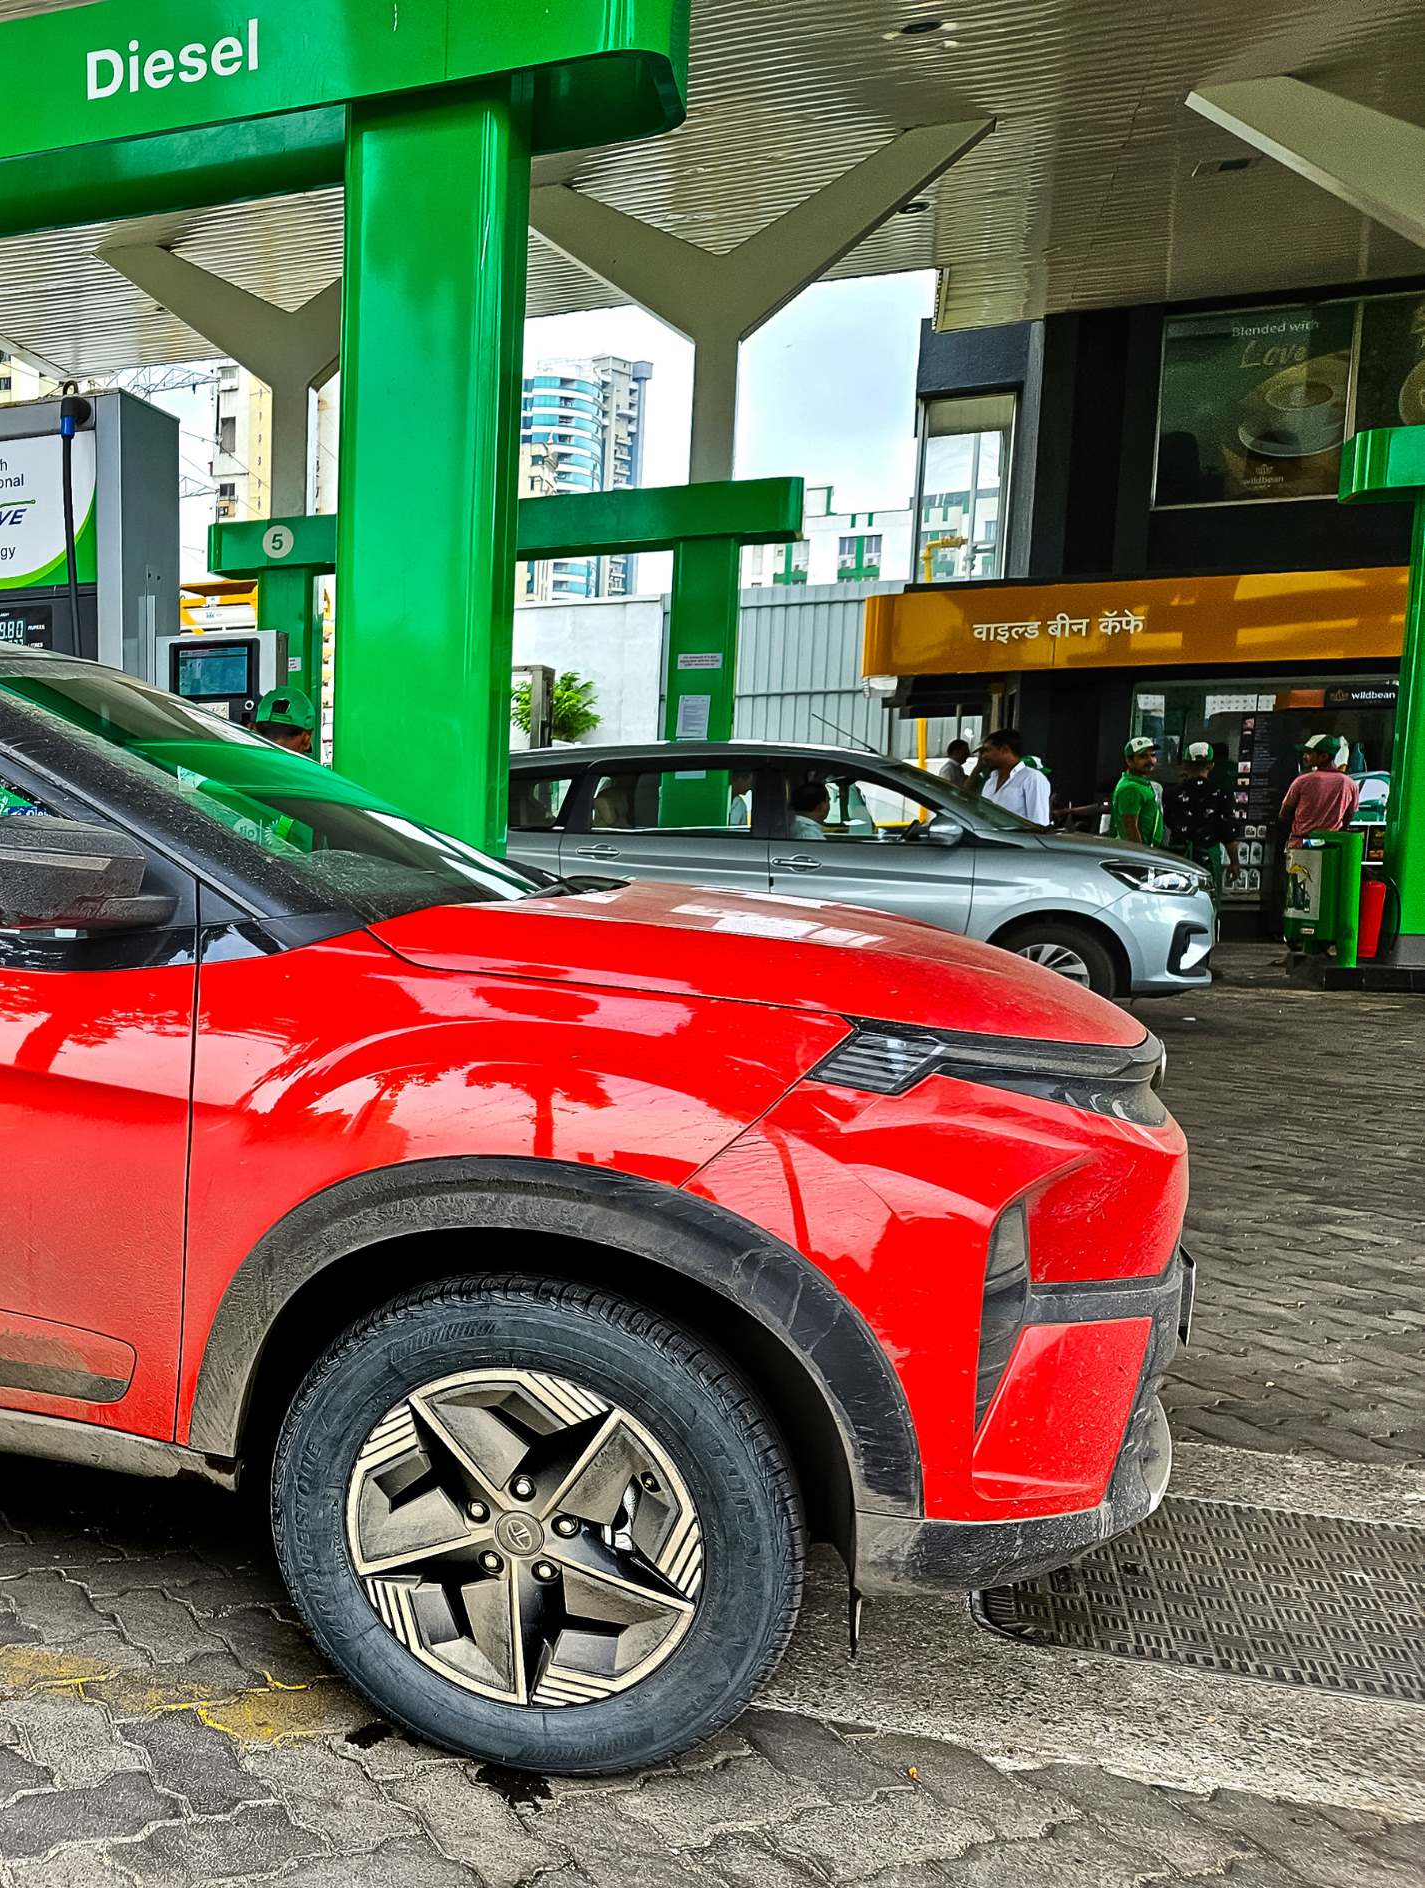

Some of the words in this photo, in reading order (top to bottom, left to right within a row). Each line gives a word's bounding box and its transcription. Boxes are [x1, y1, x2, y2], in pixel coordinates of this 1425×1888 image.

[86, 17, 260, 101] Diesel
[1231, 323, 1287, 338] Blended
[1289, 319, 1320, 332] with
[271, 532, 284, 551] 5
[972, 620, 1042, 644] वाइल्ड
[1046, 613, 1090, 638] बीन
[1098, 608, 1146, 636] कॅफे
[1351, 690, 1396, 700] wildbean
